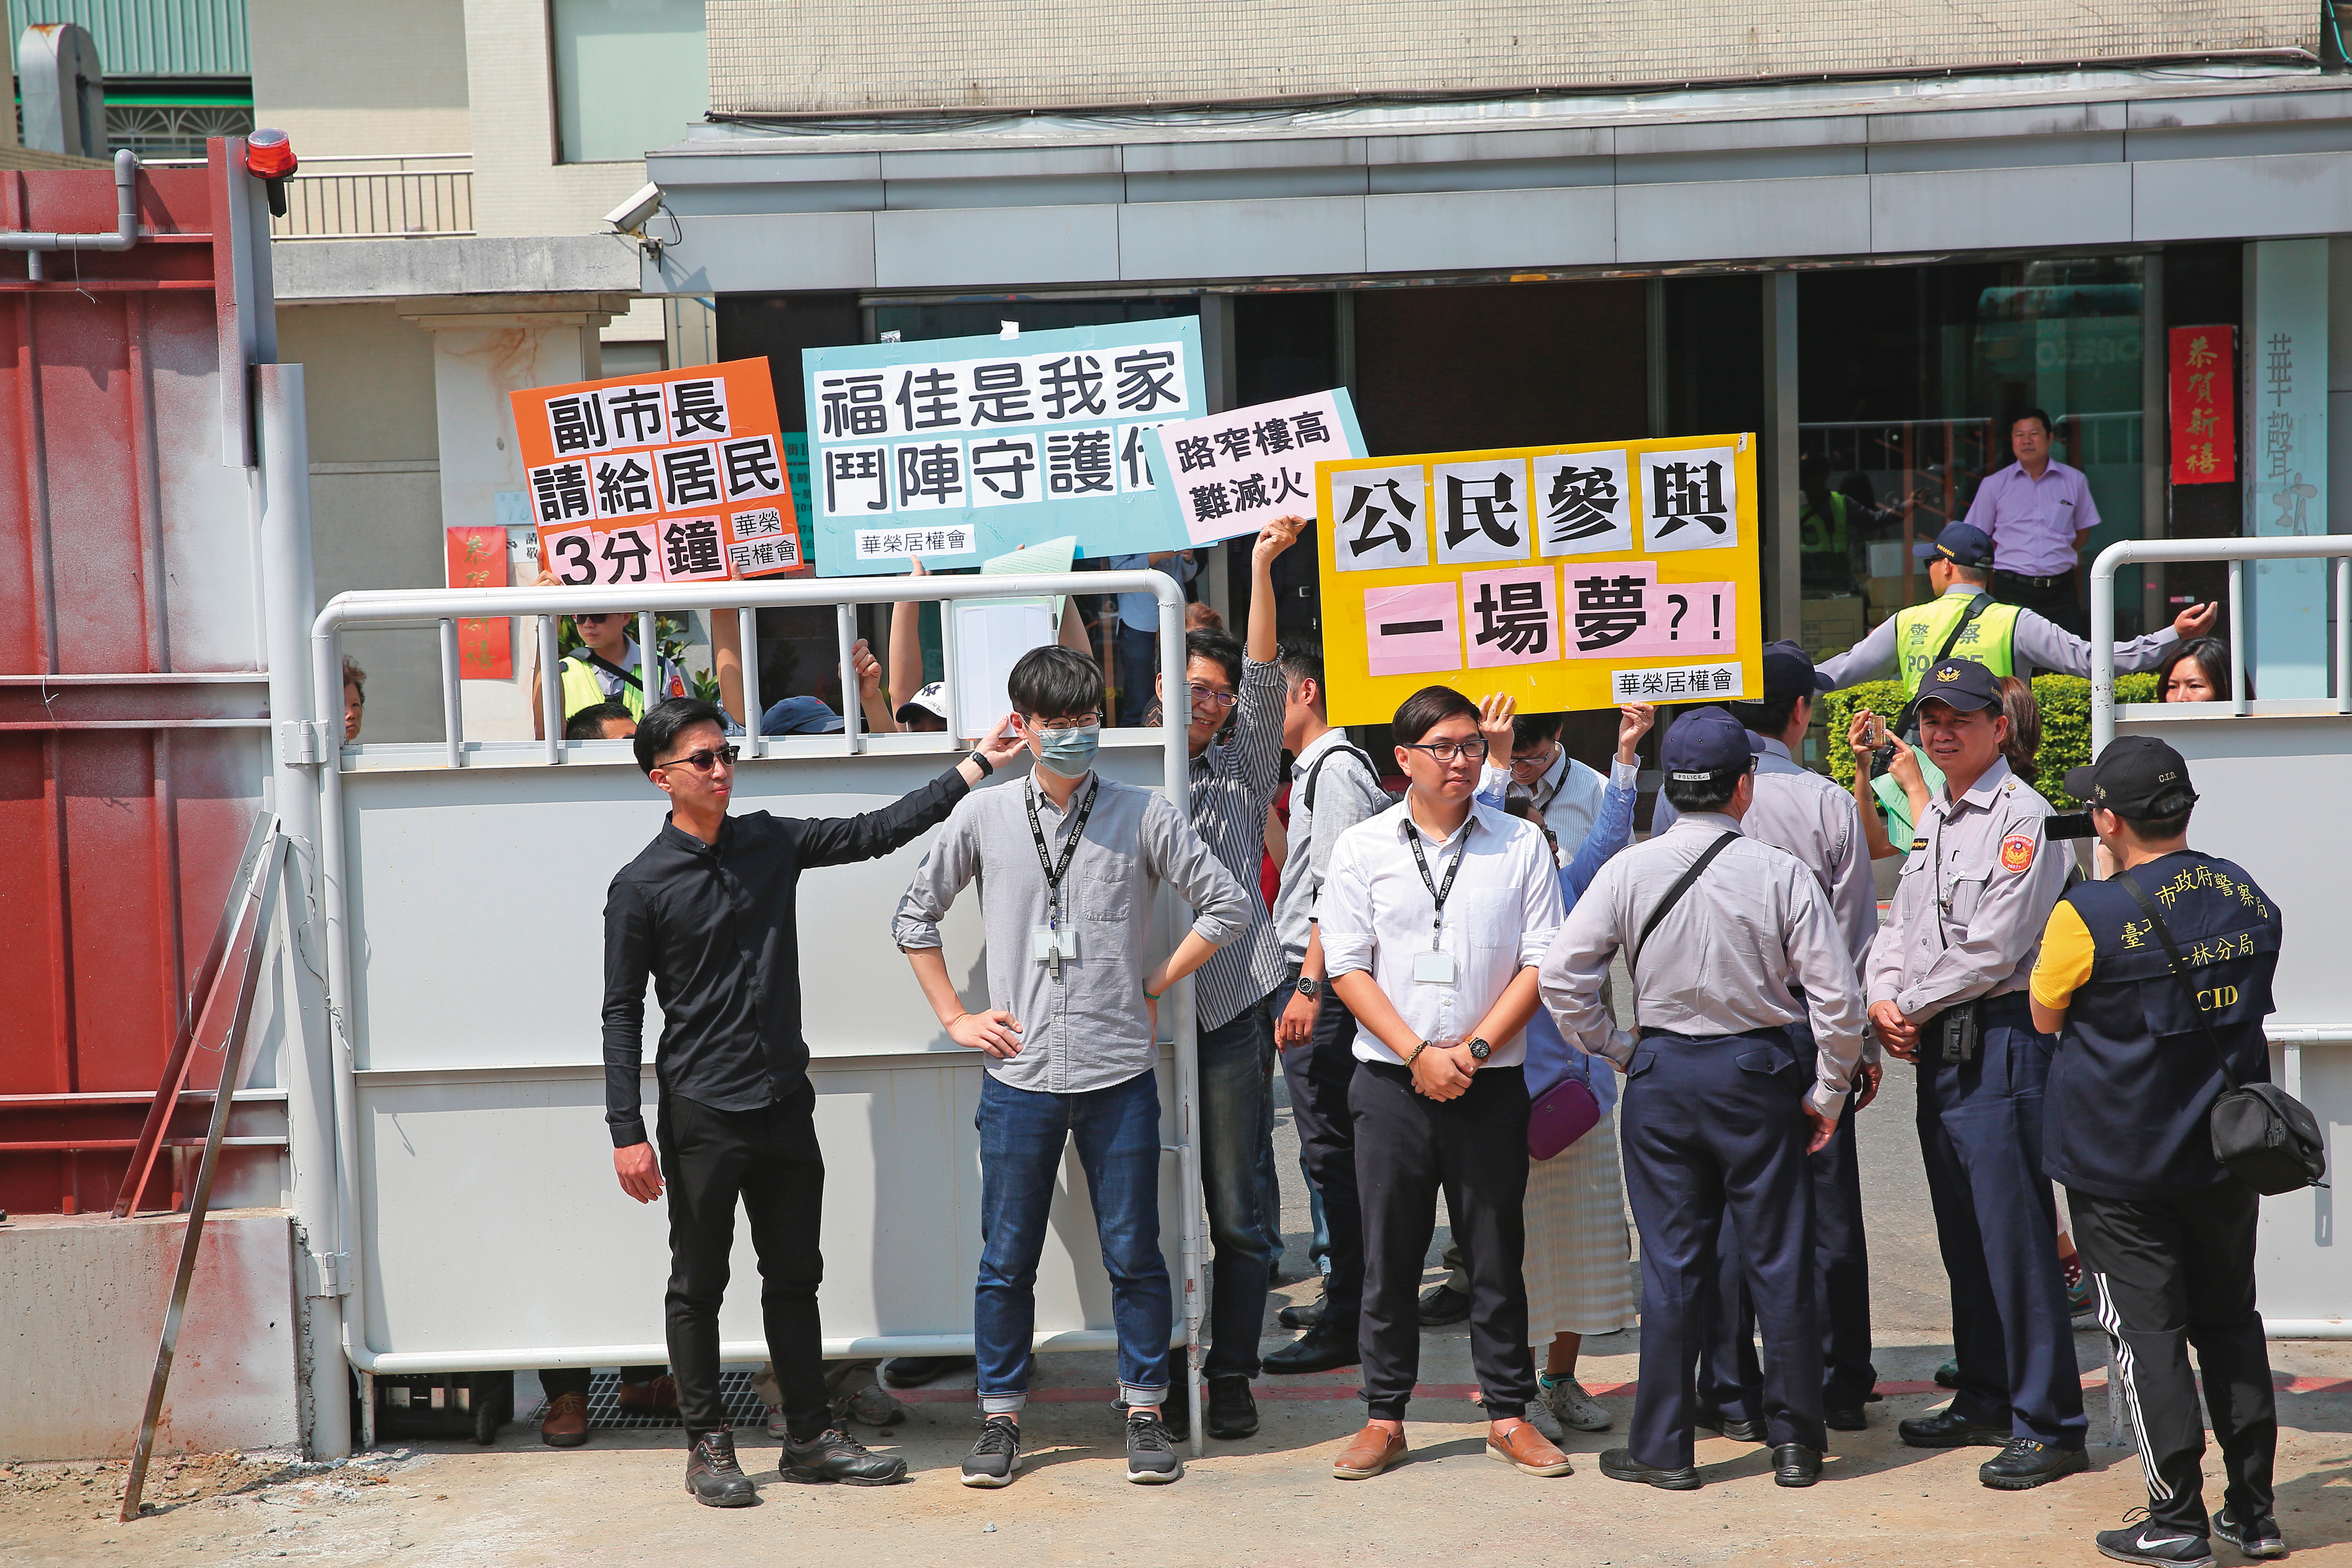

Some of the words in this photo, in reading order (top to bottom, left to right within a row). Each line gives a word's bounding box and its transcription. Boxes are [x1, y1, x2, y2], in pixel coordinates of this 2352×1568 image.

[823, 350, 1180, 437] 福佳是我家
[2185, 335, 2221, 474] 恭賀新禧
[549, 381, 726, 453] 副市長
[1175, 411, 1330, 474] 路窄樓高
[533, 438, 781, 522] 請給居民
[1189, 467, 1310, 523] 難滅火
[735, 511, 781, 537] 華榮
[1342, 460, 1728, 557] 公民參與
[555, 521, 723, 586] 3分鐘
[730, 539, 796, 568] 居權會
[861, 530, 966, 555] 華榮居權會
[1380, 575, 1721, 655] 一場夢?!
[1910, 623, 1981, 645] 警察
[1619, 668, 1733, 696] 華榮居權會
[2158, 772, 2177, 782] C.I.D.
[1073, 820, 1082, 835] TAIPEI
[1059, 853, 1068, 868] TAIPEI
[2168, 933, 2254, 973] 林分局
[2196, 985, 2238, 1011] CID
